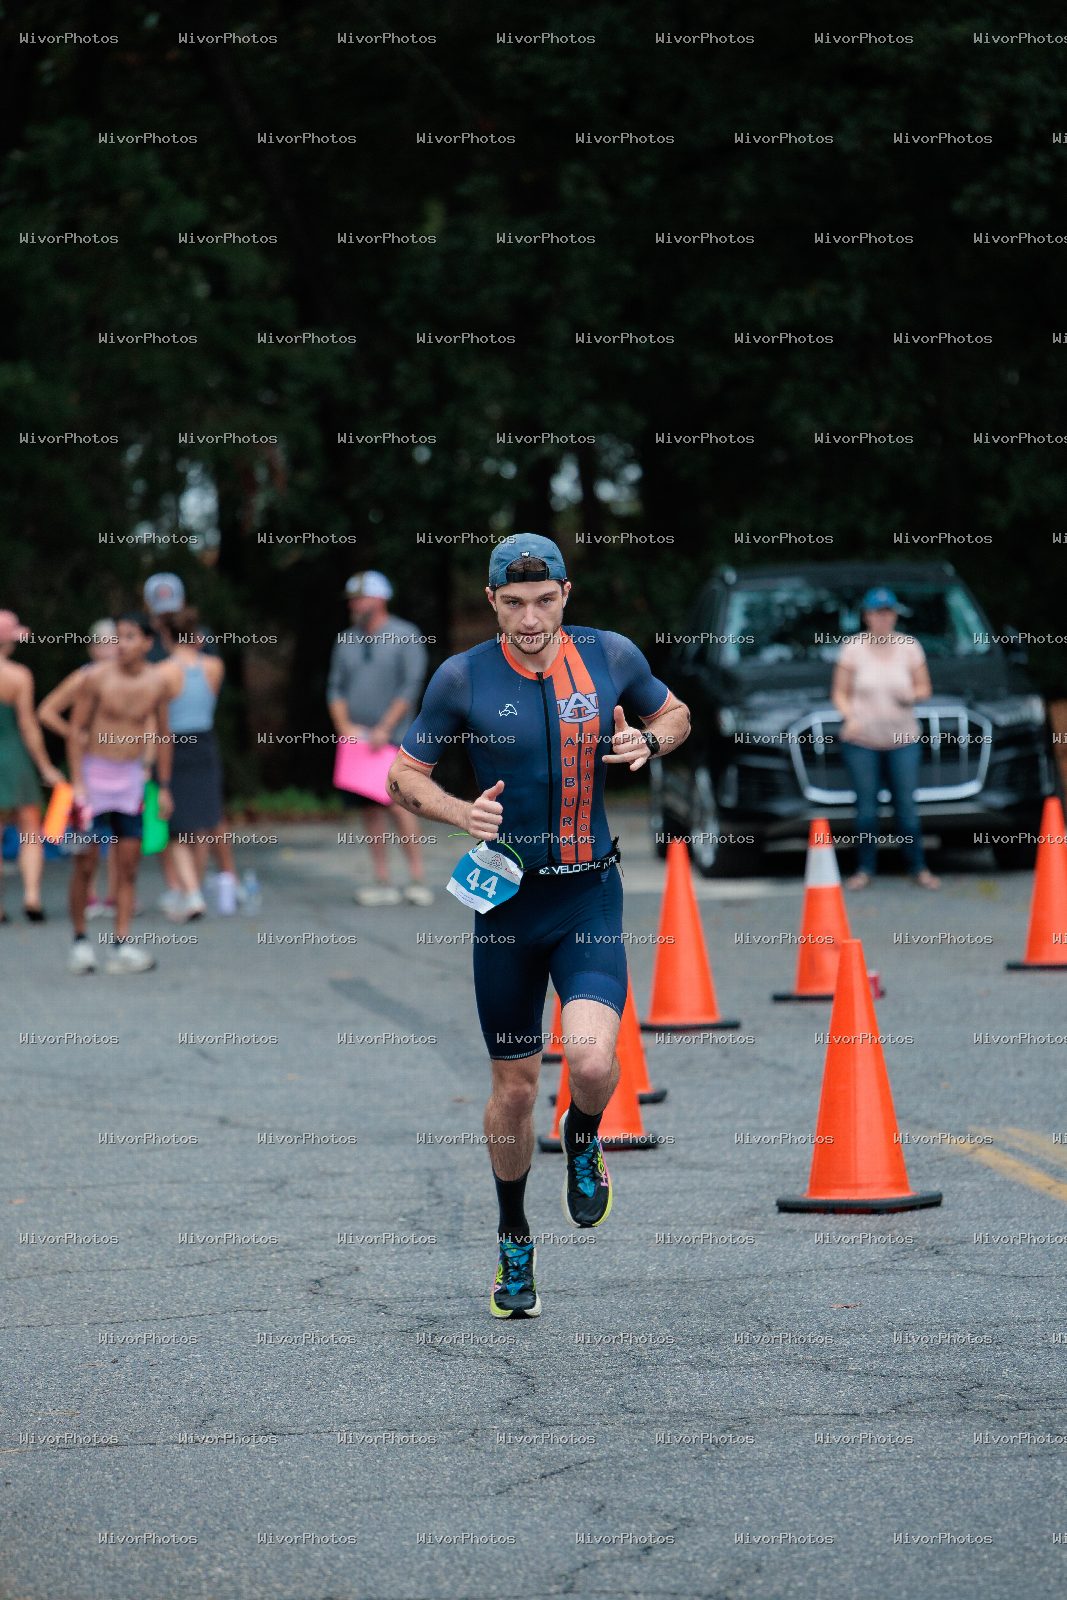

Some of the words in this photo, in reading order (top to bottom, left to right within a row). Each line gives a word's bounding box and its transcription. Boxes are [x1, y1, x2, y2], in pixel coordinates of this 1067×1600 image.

[561, 736, 576, 847] AUBURN
[580, 732, 594, 844] TRIATHLON
[465, 867, 499, 899] 44
